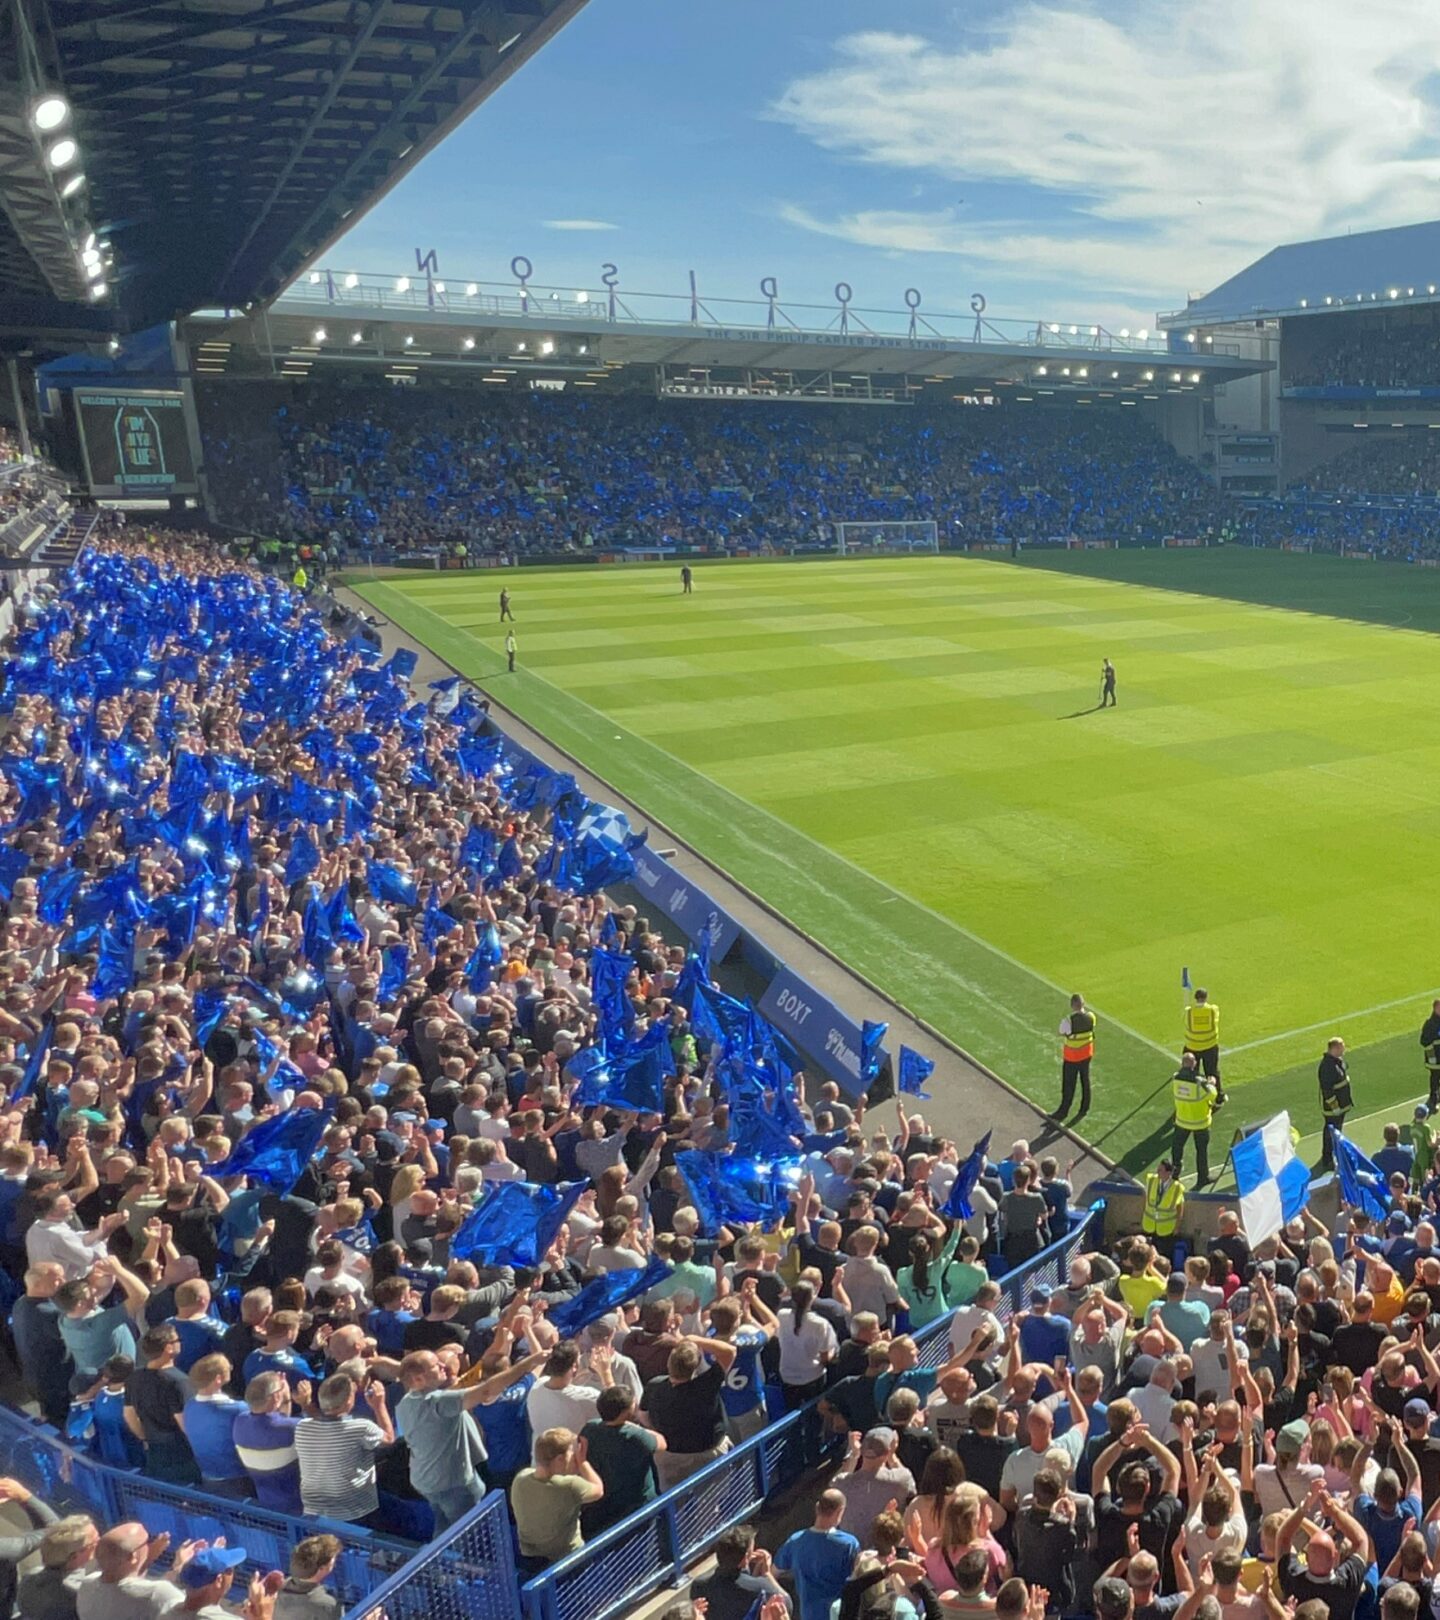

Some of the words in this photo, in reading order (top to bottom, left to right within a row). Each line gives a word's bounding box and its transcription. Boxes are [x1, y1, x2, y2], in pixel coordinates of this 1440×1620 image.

[706, 329, 729, 339] THE
[738, 330, 760, 341] SIR
[766, 331, 810, 344] PHILIP
[815, 334, 864, 346] CARTER
[870, 338, 902, 348] PARK
[909, 339, 947, 352] STAND
[776, 988, 812, 1025] BOXT
[721, 1367, 749, 1390] 6
